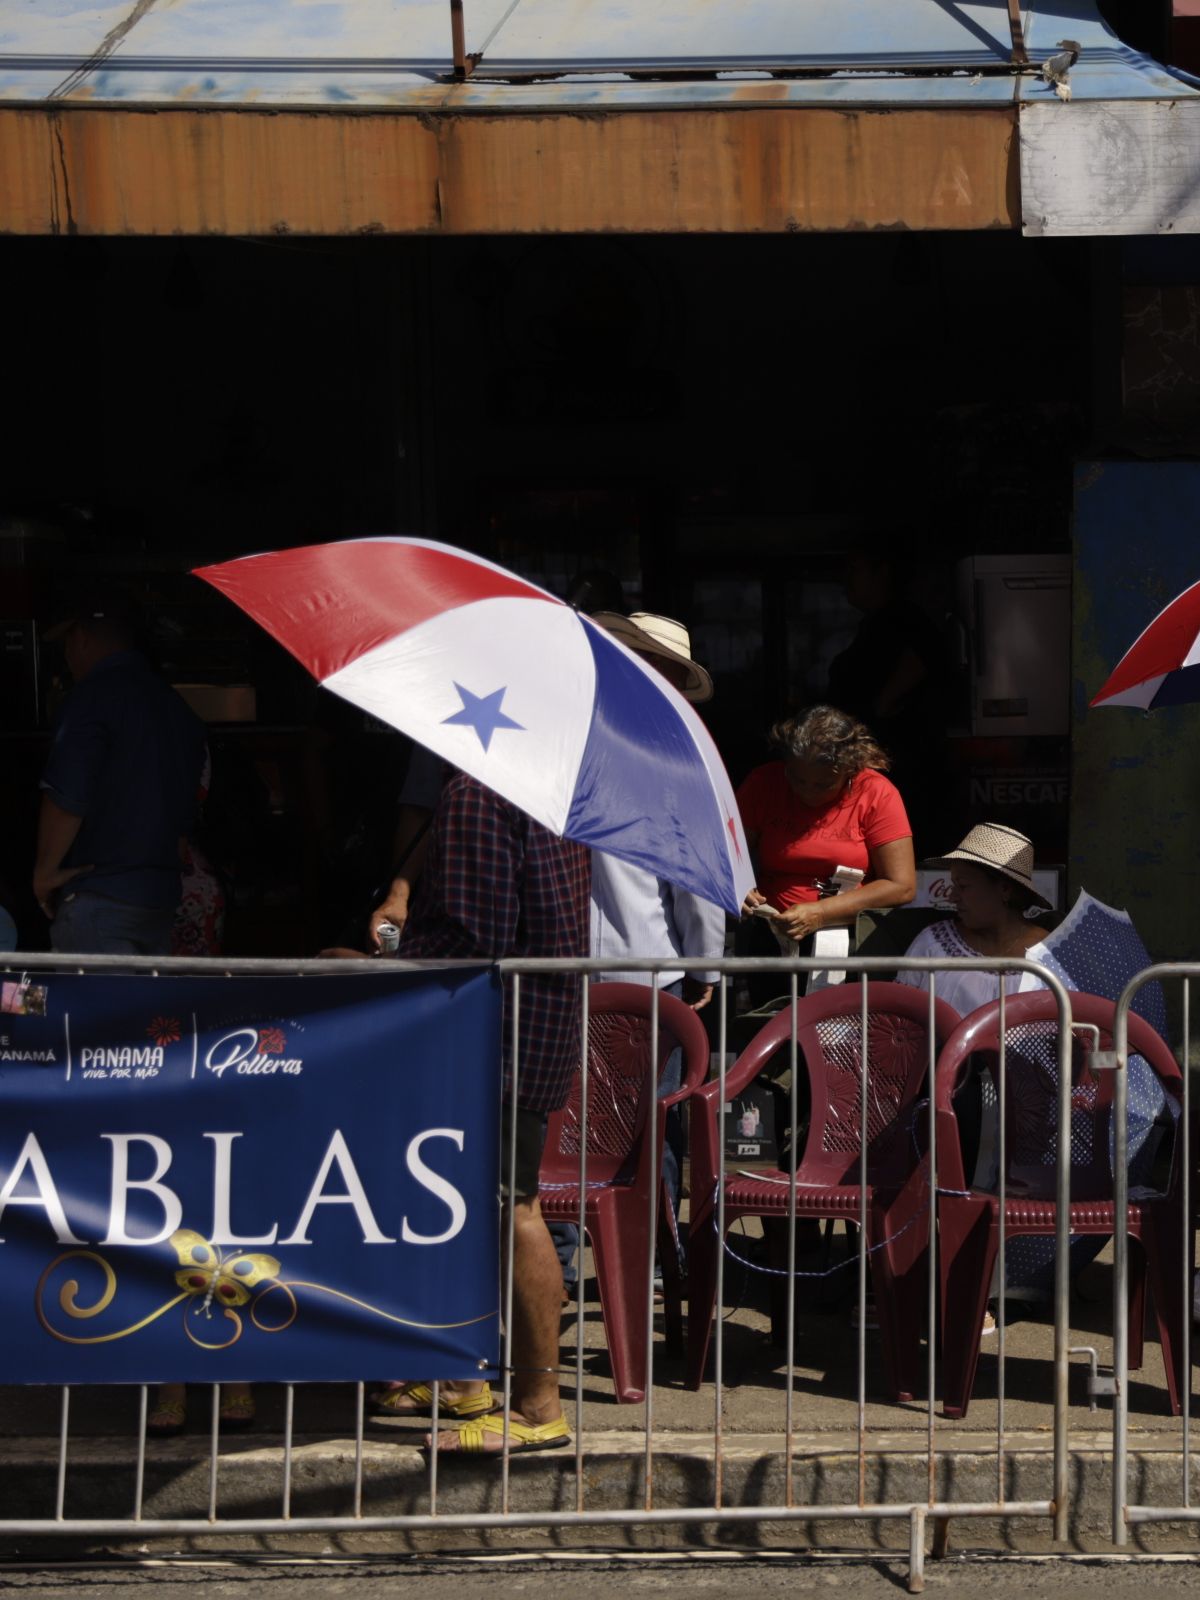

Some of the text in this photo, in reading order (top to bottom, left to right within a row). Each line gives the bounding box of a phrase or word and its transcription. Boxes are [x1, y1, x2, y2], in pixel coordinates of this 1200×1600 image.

[80, 1046, 164, 1069] PANAMA
[205, 1028, 303, 1079] Polleras
[83, 1068, 108, 1079] VIVE
[110, 1068, 132, 1079] POR
[0, 1127, 468, 1246] ABLAS
